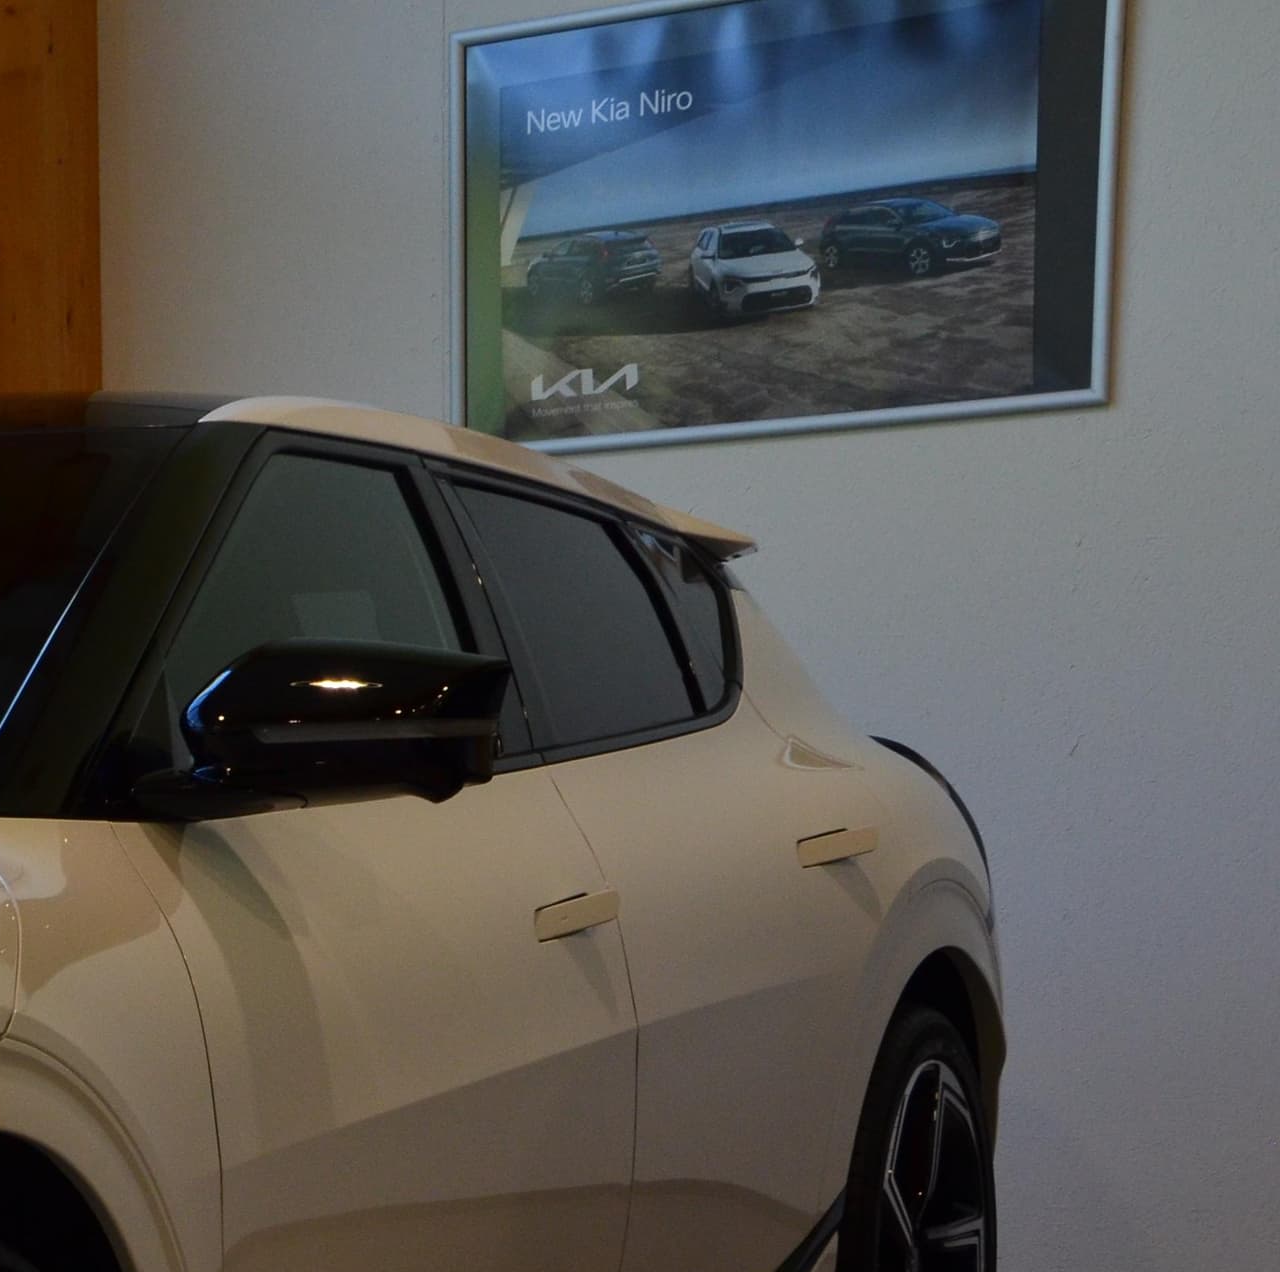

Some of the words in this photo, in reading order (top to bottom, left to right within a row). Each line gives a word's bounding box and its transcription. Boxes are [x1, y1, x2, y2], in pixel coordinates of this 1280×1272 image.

[527, 109, 583, 135] New
[591, 97, 630, 124] Kia
[640, 90, 693, 117] Niro
[531, 363, 639, 401] KIA
